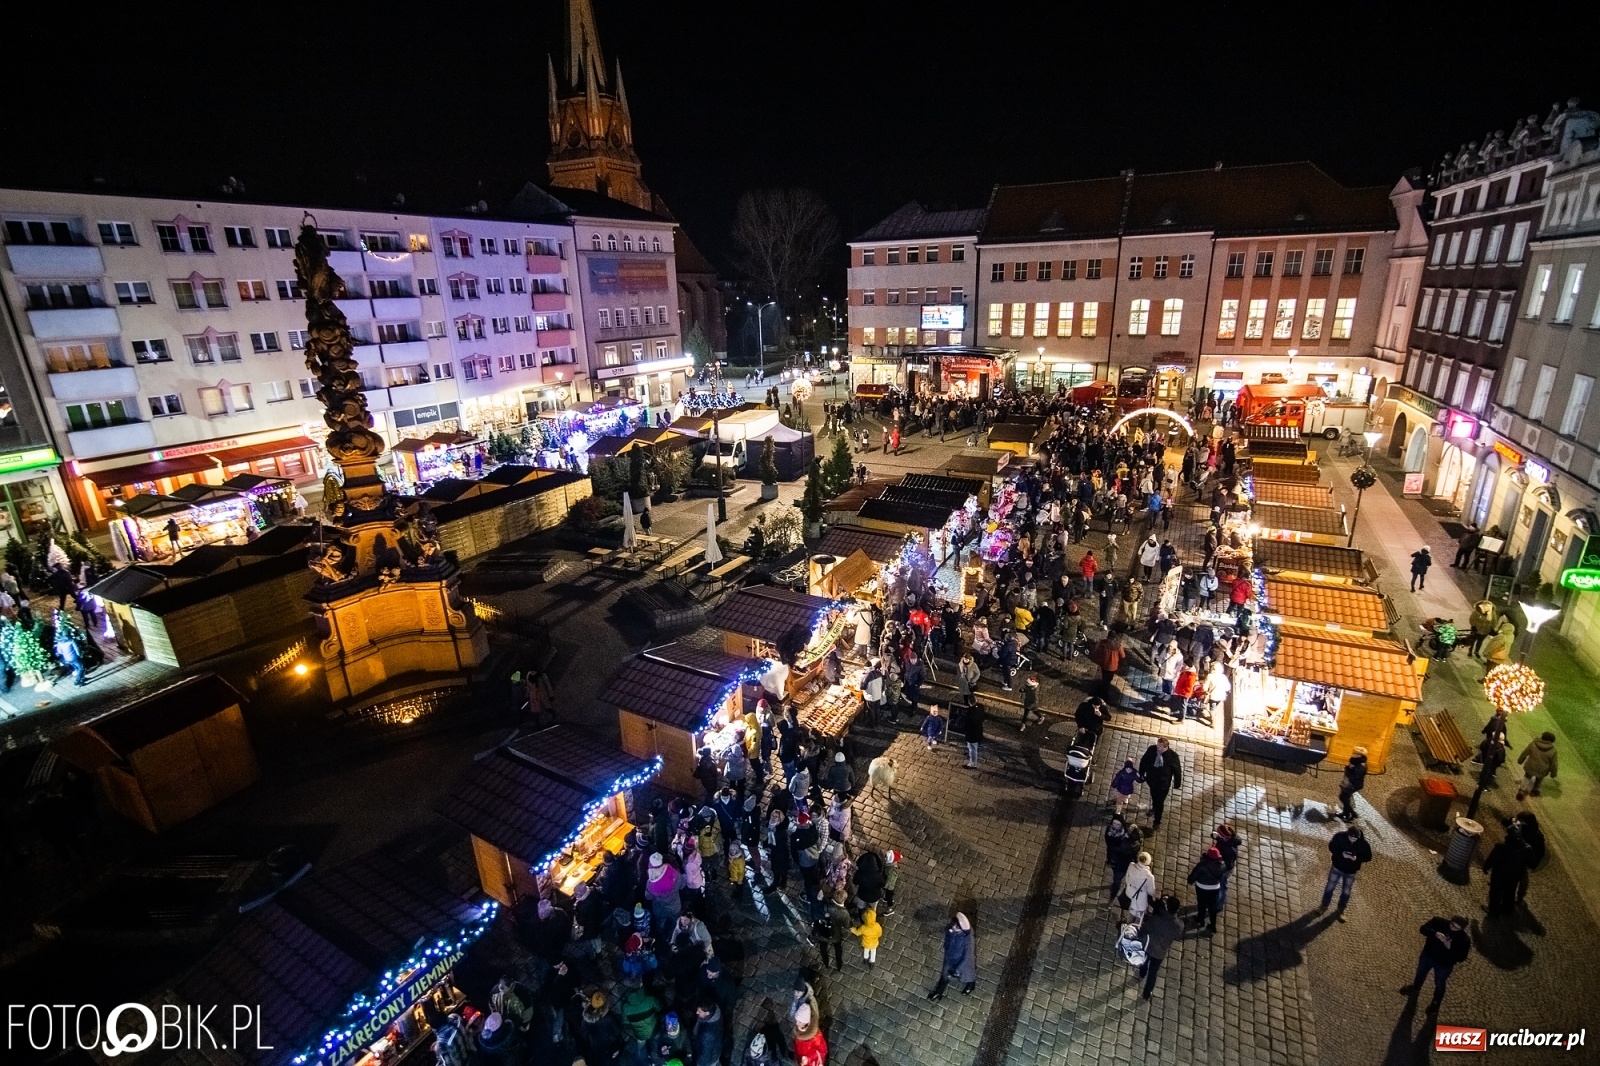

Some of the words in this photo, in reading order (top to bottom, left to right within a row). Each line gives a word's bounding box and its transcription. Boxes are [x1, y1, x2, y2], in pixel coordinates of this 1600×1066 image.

[417, 409, 437, 418] empik
[1524, 459, 1548, 483] SHIRO
[328, 993, 407, 1066] ZAKRĘCONY
[407, 951, 465, 1001] ZIEMNIAK
